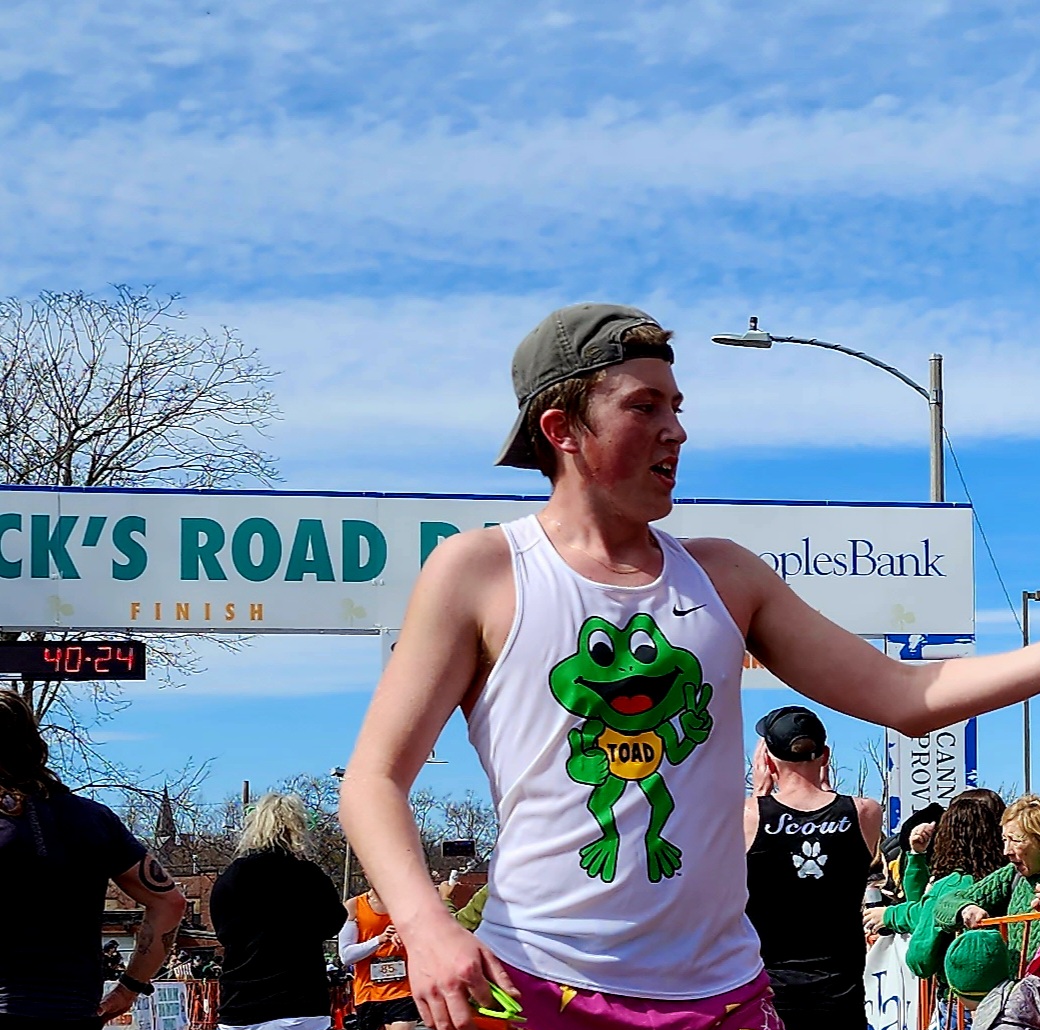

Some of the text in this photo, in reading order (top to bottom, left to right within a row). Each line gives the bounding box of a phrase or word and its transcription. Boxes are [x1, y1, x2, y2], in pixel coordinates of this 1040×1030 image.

[179, 517, 388, 584] ROAD
[130, 602, 264, 622] FINISH
[606, 742, 655, 764] TOAD
[935, 731, 957, 811] CANN
[764, 812, 852, 836] Scout
